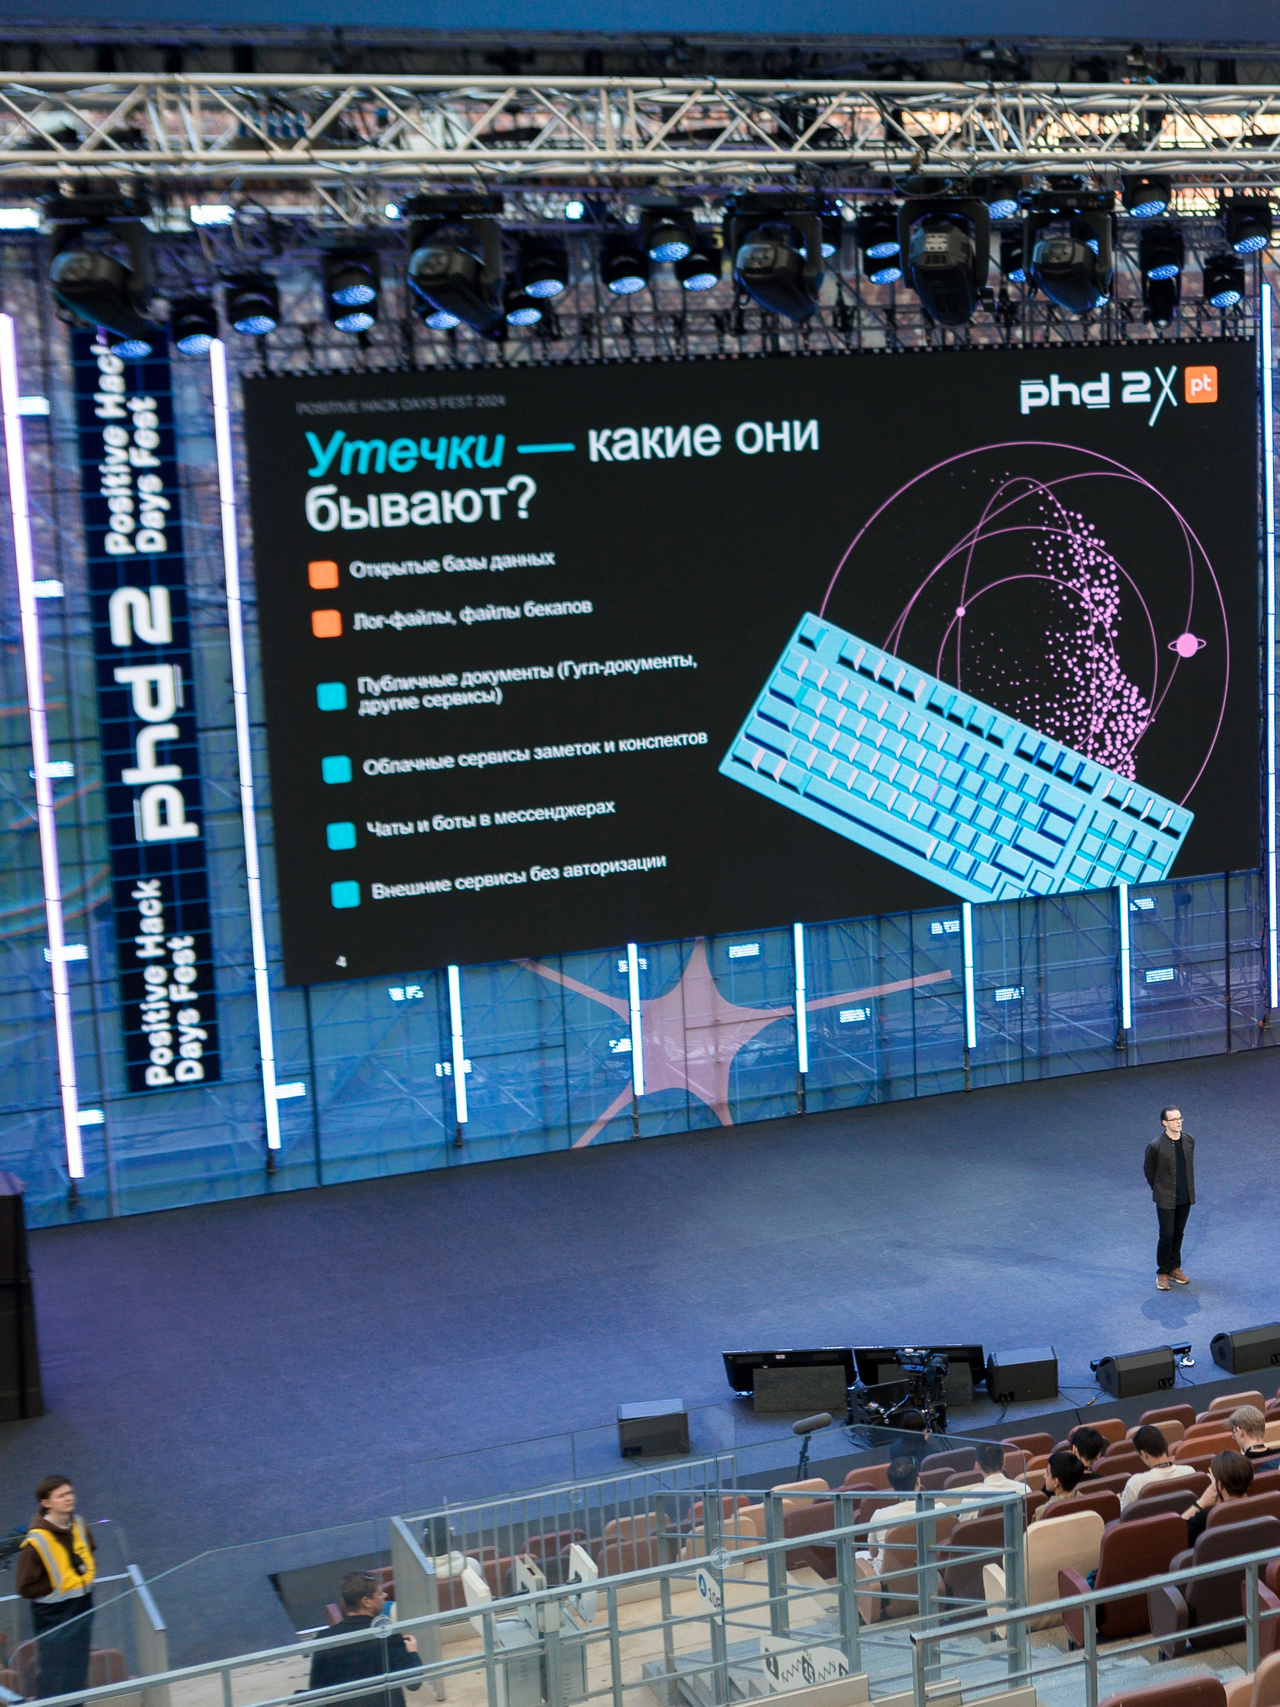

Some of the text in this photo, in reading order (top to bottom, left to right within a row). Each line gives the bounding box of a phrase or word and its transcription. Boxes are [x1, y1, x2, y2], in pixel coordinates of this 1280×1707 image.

[1020, 372, 1110, 415] phd
[305, 429, 506, 478] Утечки
[588, 422, 722, 462] какие
[735, 419, 820, 455] они
[99, 425, 137, 554] Positive
[127, 396, 171, 553] Days Fest
[305, 474, 537, 531] бывают?
[349, 552, 556, 580] Открытые базы данных
[353, 600, 593, 631] Лог-файлы, файлы бекапов
[357, 653, 698, 696] Публичные документы (Гугл-документы,
[109, 585, 199, 842] phd 2
[358, 687, 503, 716] другие сервисы)
[363, 731, 709, 776] Облачные сервисы заметок и конспектов
[366, 801, 616, 838] Чаты и боты в мессенджерах
[371, 855, 667, 900] Внешние сервисы без авторизации
[131, 879, 175, 1087] Positive Hack
[167, 935, 208, 1083] Days Fest
